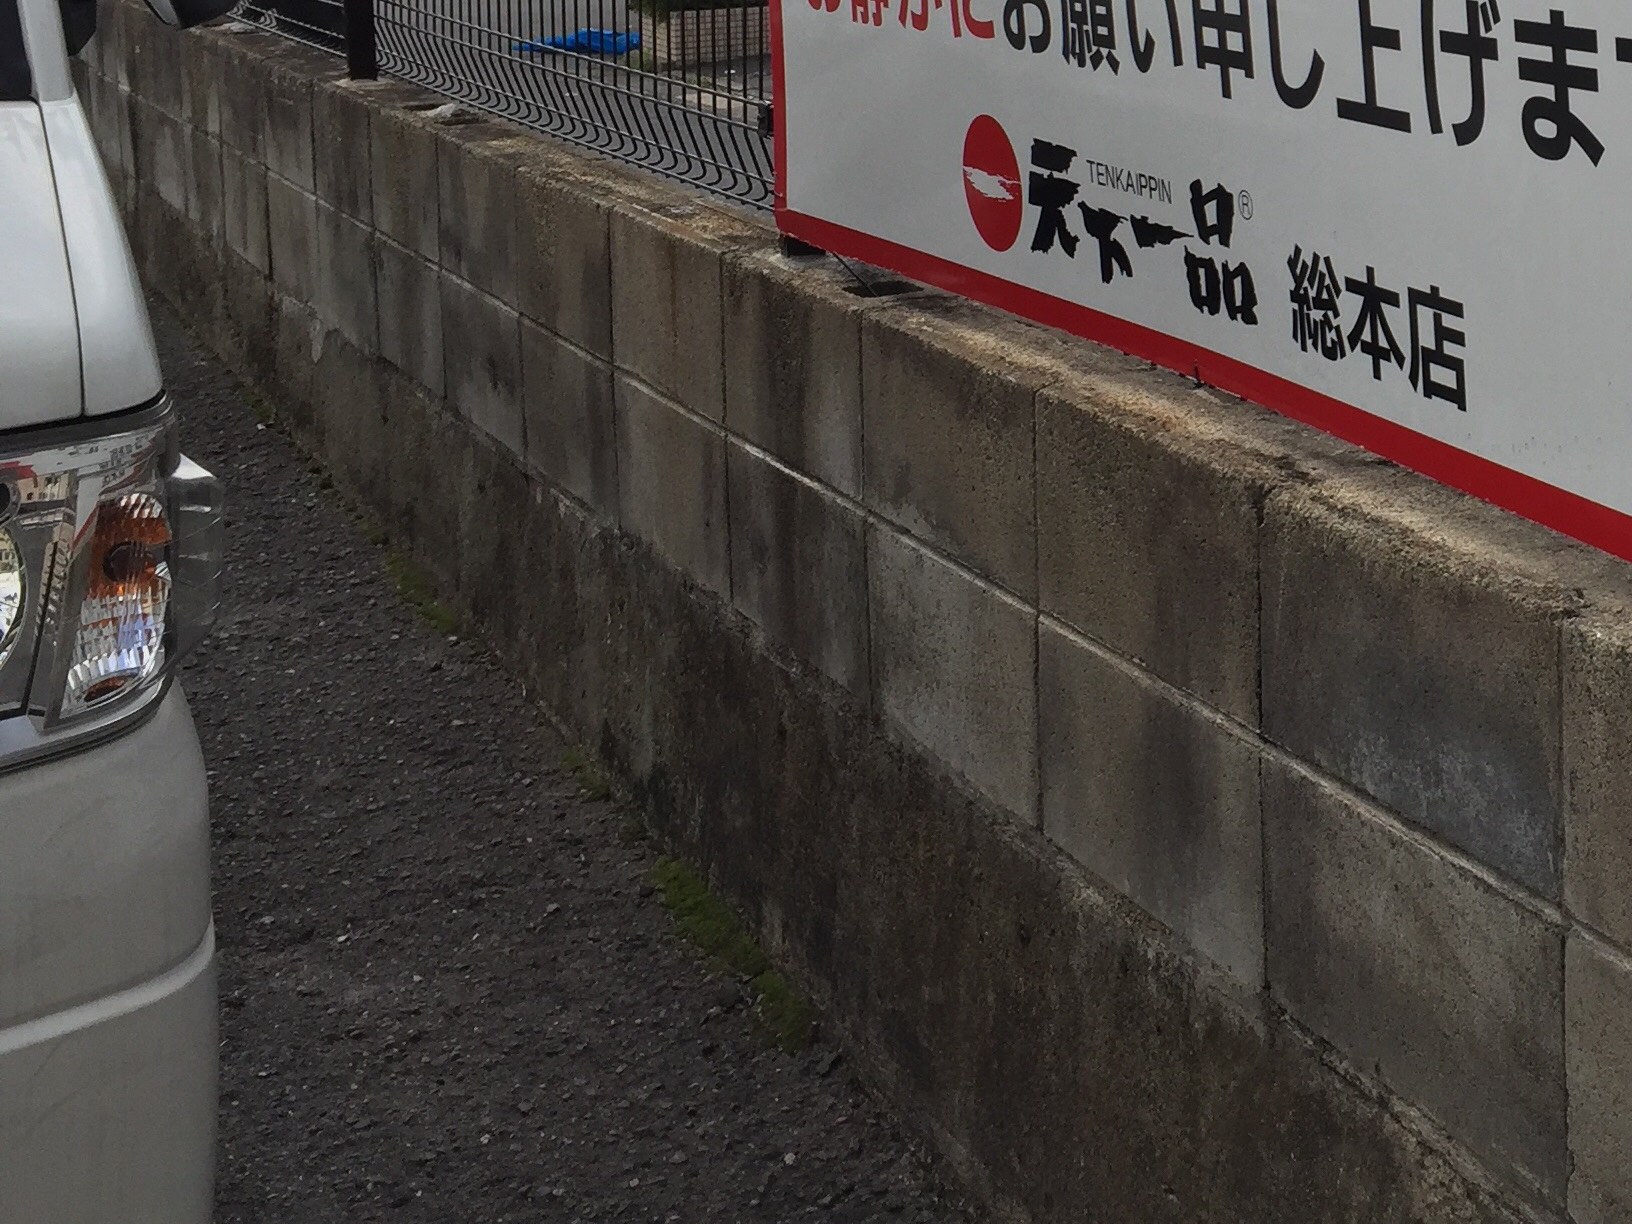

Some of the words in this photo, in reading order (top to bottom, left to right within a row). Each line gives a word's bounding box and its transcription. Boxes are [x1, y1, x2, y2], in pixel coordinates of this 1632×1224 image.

[1086, 159, 1173, 205] TENKAIPPIN
[1028, 137, 1259, 325] 天下一品
[1286, 242, 1468, 411] 総本店
